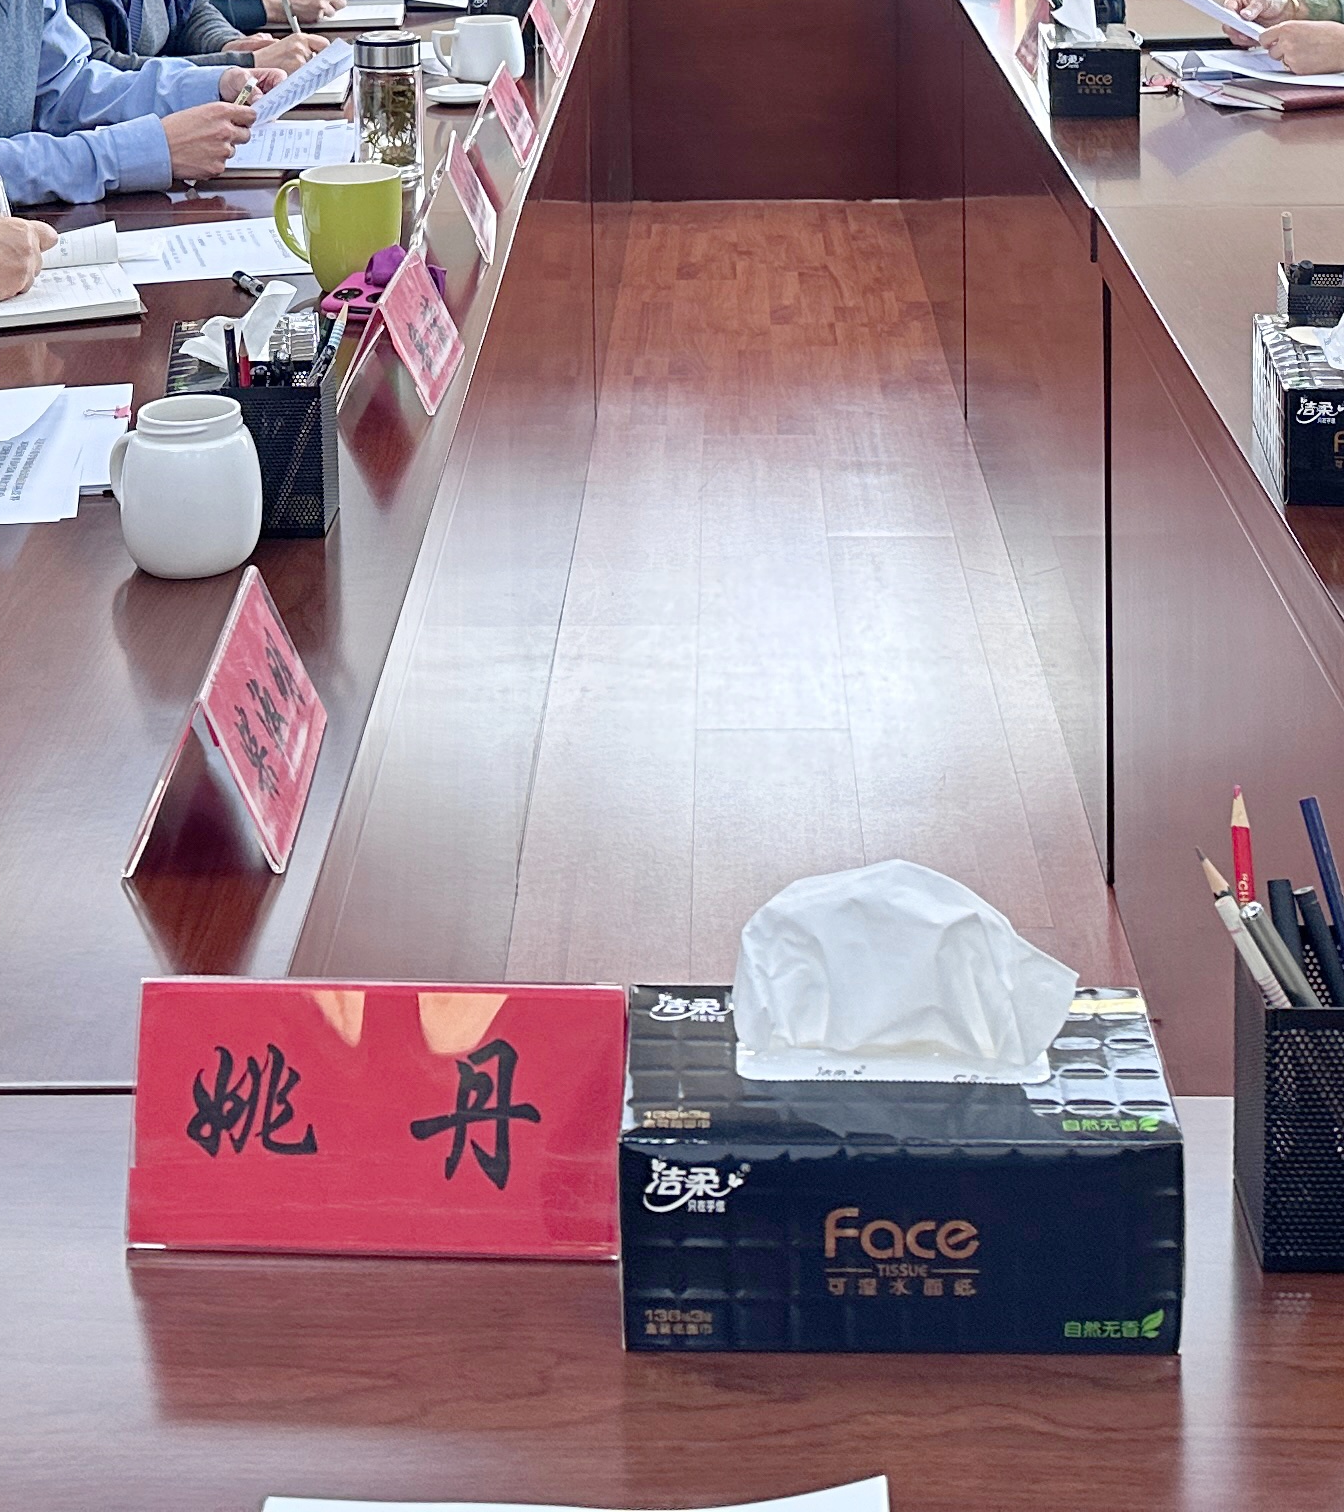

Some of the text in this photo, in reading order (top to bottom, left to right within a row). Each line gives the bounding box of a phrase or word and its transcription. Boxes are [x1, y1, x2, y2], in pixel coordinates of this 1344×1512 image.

[1077, 71, 1113, 85] Face
[185, 1038, 543, 1193] 姚丹
[1061, 1117, 1139, 1133] 自然无香
[644, 1162, 722, 1198] 洁柔
[824, 1207, 980, 1260] Face
[877, 1263, 929, 1277] TISSUE
[1064, 1320, 1141, 1339] 自然无香
